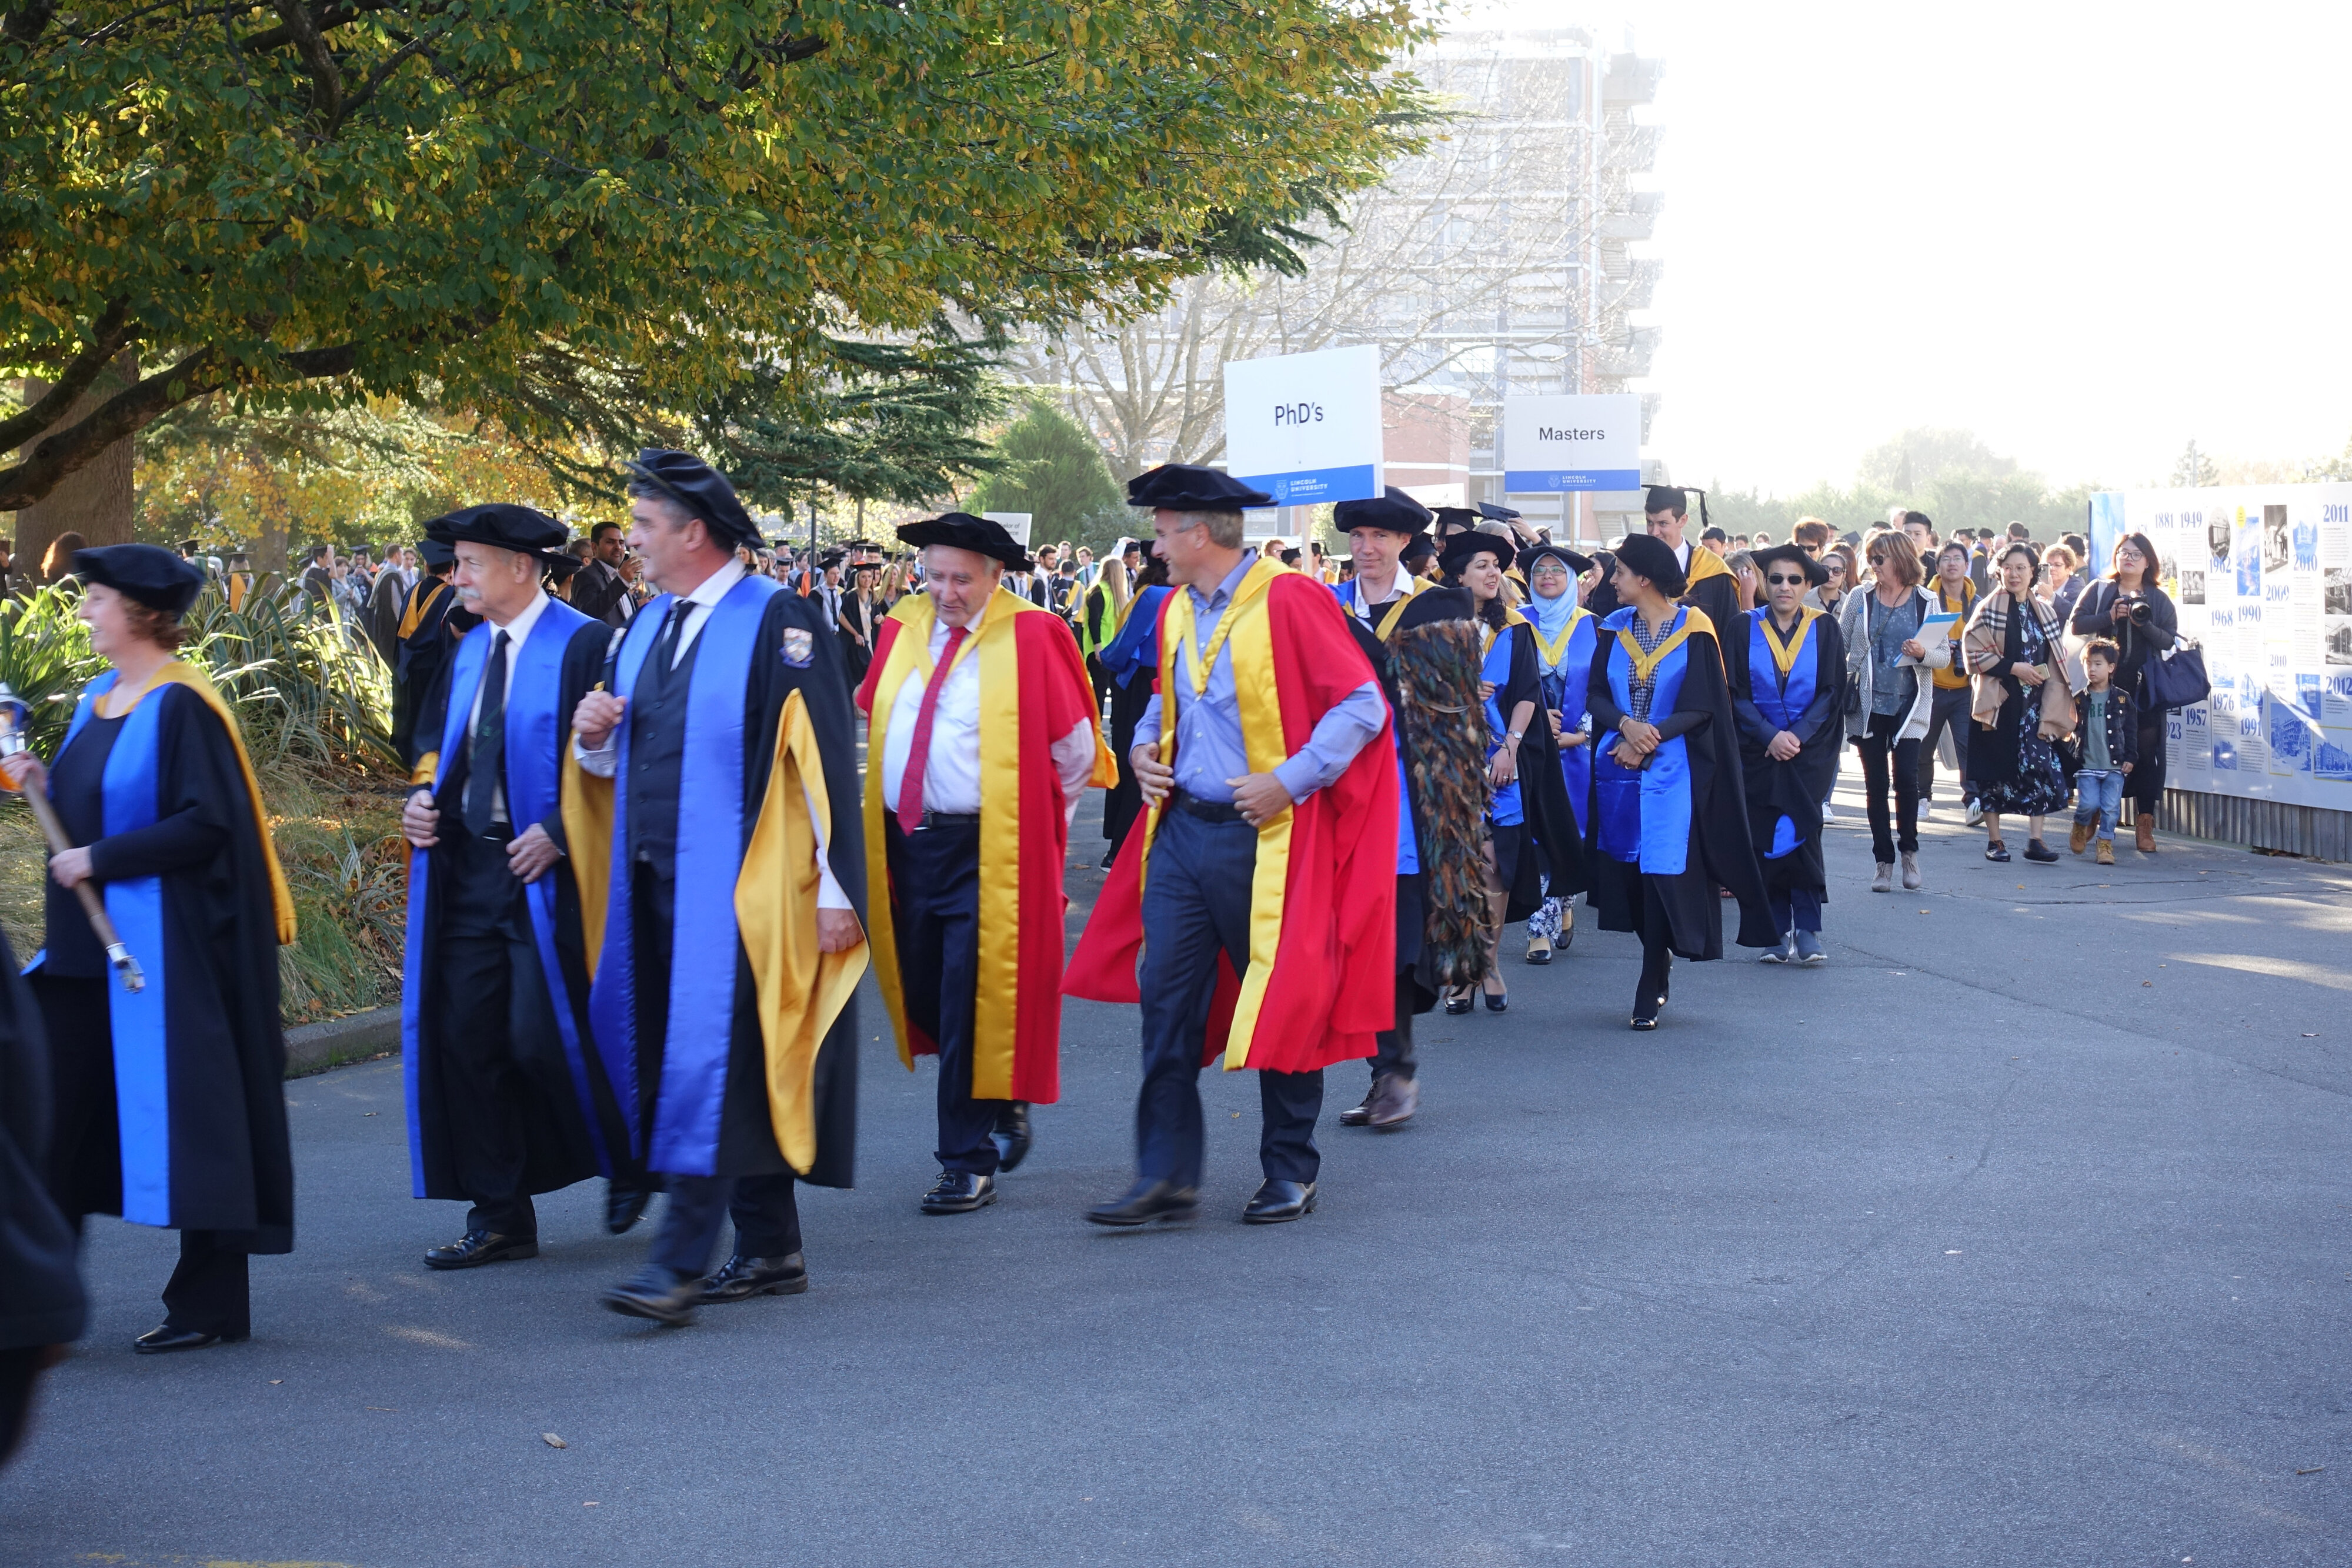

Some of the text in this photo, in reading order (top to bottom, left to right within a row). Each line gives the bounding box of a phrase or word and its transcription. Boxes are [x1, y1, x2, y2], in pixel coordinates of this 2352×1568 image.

[1275, 402, 1323, 426] PhD's
[1539, 427, 1604, 441] Masters
[1290, 483, 1328, 492] UNIVERSITY
[2155, 512, 2174, 528] 1881
[2180, 511, 2203, 528] 1949
[2323, 504, 2348, 522] 2011
[2210, 556, 2231, 573] 1962
[2294, 554, 2317, 572] 2010
[2266, 585, 2289, 602] 2009
[2211, 609, 2233, 626] 1968
[2238, 605, 2261, 622] 1990
[2270, 654, 2287, 668] 2010
[2326, 676, 2352, 695] 2012
[2090, 703, 2105, 718] RE
[2213, 693, 2234, 711] 1976
[2186, 708, 2207, 726] 1957
[2166, 722, 2181, 739] 923
[2241, 718, 2261, 736] 1991
